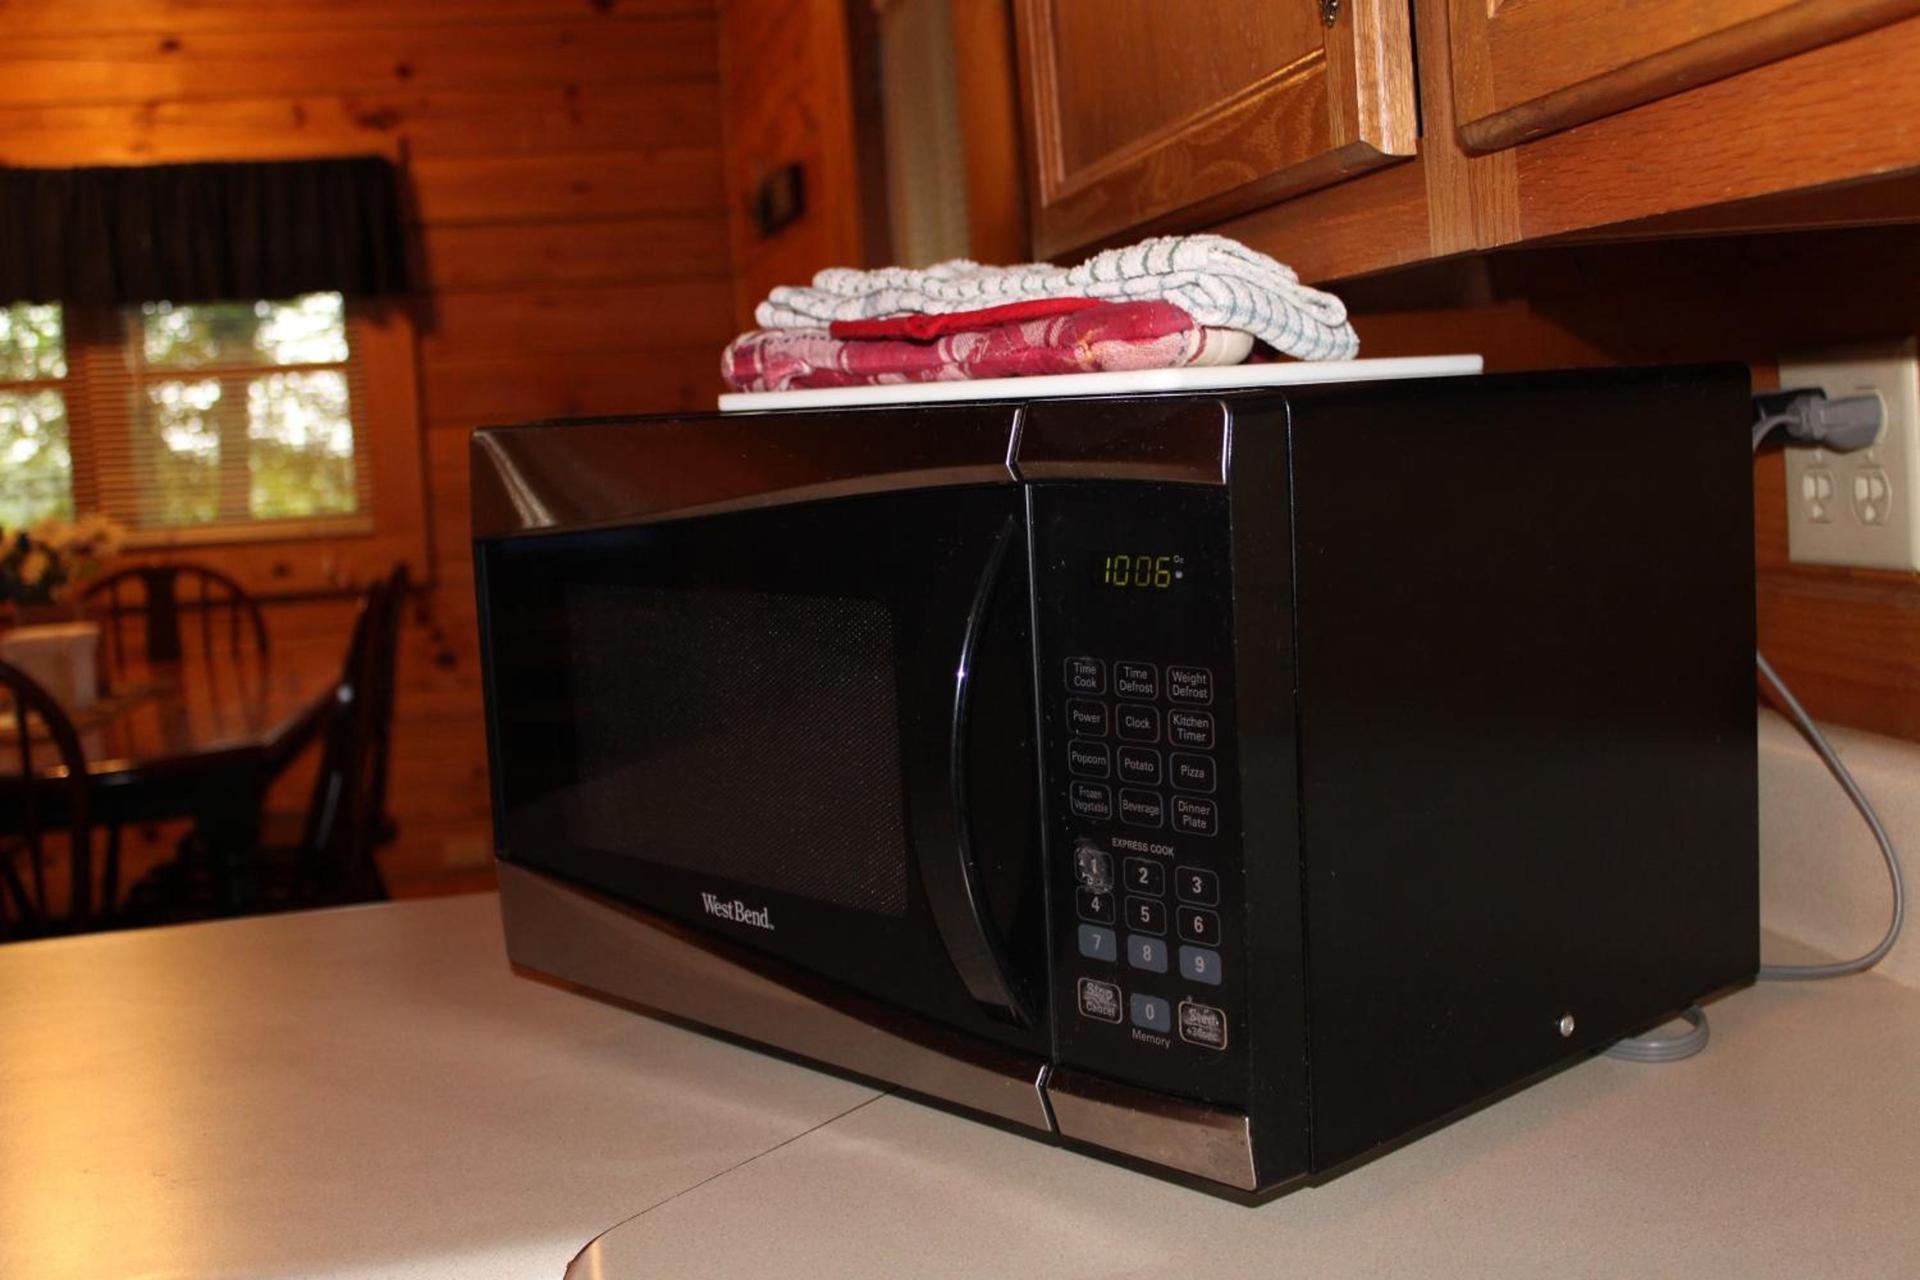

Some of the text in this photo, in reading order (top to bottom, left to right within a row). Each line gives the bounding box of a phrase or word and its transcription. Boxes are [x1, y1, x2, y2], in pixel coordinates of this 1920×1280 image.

[1073, 662, 1096, 674] Time
[1124, 666, 1148, 680] Time
[1073, 676, 1097, 688] Cook
[1172, 670, 1206, 686] Weight
[1119, 680, 1153, 694] Defrost
[1172, 685, 1208, 699] Defrost
[1073, 710, 1101, 724] Power
[1125, 715, 1150, 729] Clock
[1173, 715, 1209, 729] Kitchen
[1177, 728, 1207, 741] Timer
[1072, 751, 1107, 766] Popcorn
[1124, 758, 1154, 773] Potato
[1180, 764, 1205, 779] Pizza
[1123, 801, 1160, 817] Beverage
[1178, 800, 1211, 816] Dinner
[1183, 815, 1207, 829] Plate
[1112, 837, 1174, 857] EXPRESS COOK
[1139, 867, 1149, 884] 2
[1191, 876, 1203, 893] 3
[701, 892, 769, 929] West Bend
[1091, 896, 1101, 912] 4
[1140, 906, 1150, 922] 5
[1193, 916, 1205, 933] 6
[1091, 934, 1102, 950] 7
[1142, 945, 1153, 962] 8
[1194, 956, 1206, 973] 9
[1145, 1004, 1155, 1021] 0
[1132, 1028, 1171, 1048] Memory
